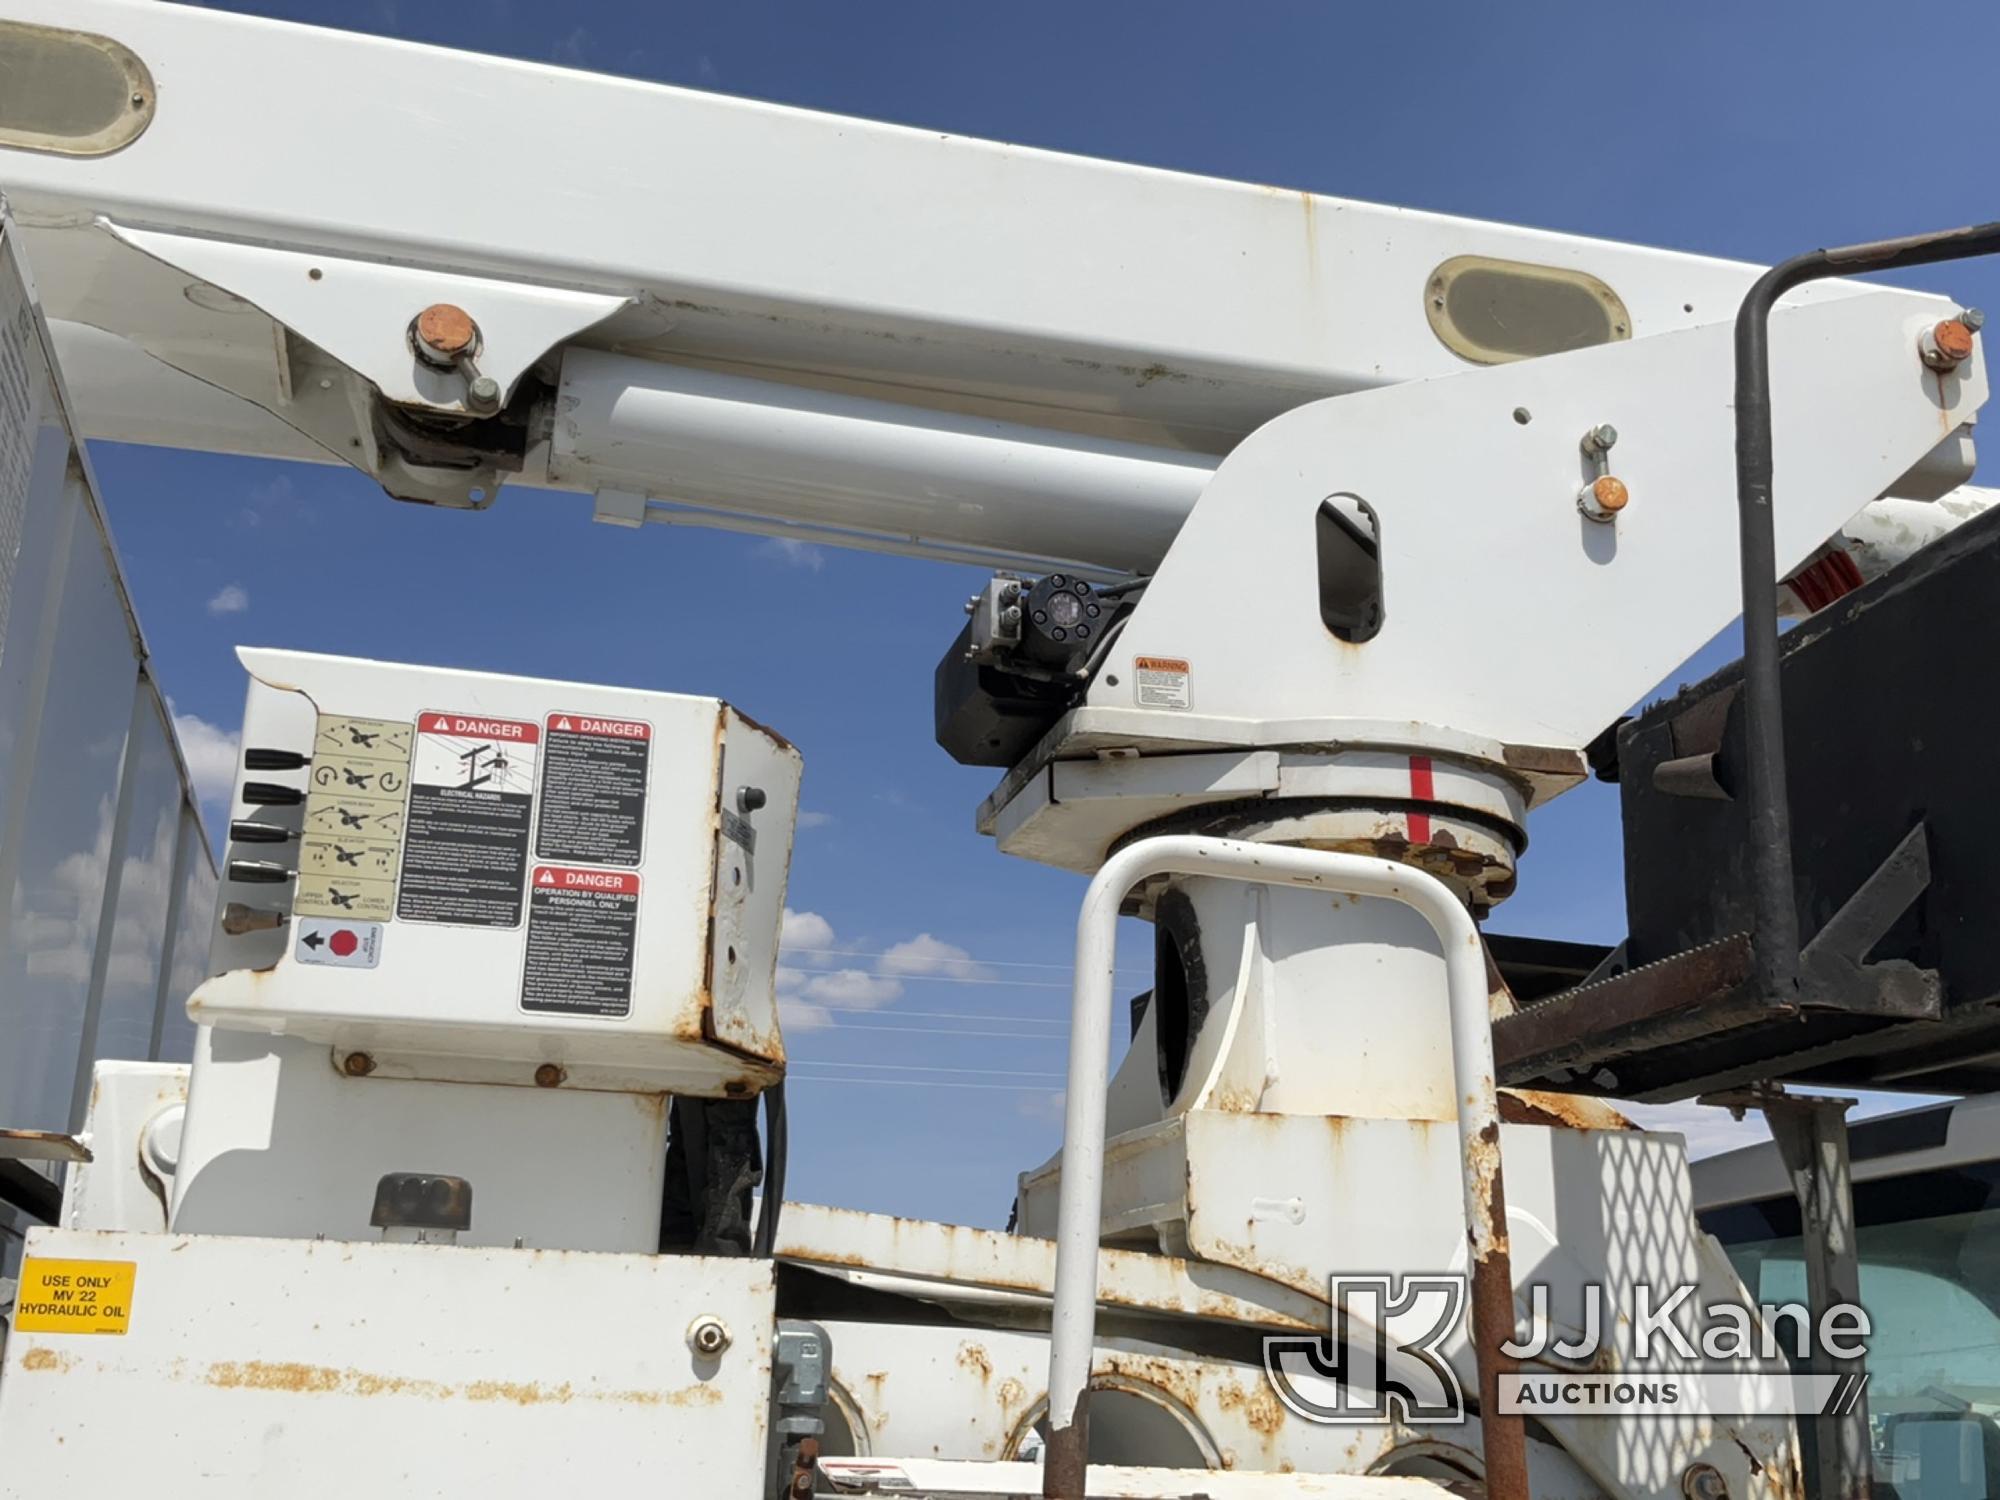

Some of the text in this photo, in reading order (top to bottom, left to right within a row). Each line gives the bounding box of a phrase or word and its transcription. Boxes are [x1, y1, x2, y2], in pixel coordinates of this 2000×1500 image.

[455, 719, 523, 738] DANGER
[580, 719, 644, 736] DANGER
[565, 873, 624, 888] DANGER
[534, 887, 579, 897] OPERATION
[594, 892, 636, 902] QUALIFIED
[548, 897, 620, 909] PERSONNEL ONLY
[42, 1275, 112, 1289] USE ONLY
[53, 1290, 97, 1302] MV 22
[19, 1303, 125, 1317] HYDRAULIC OIL
